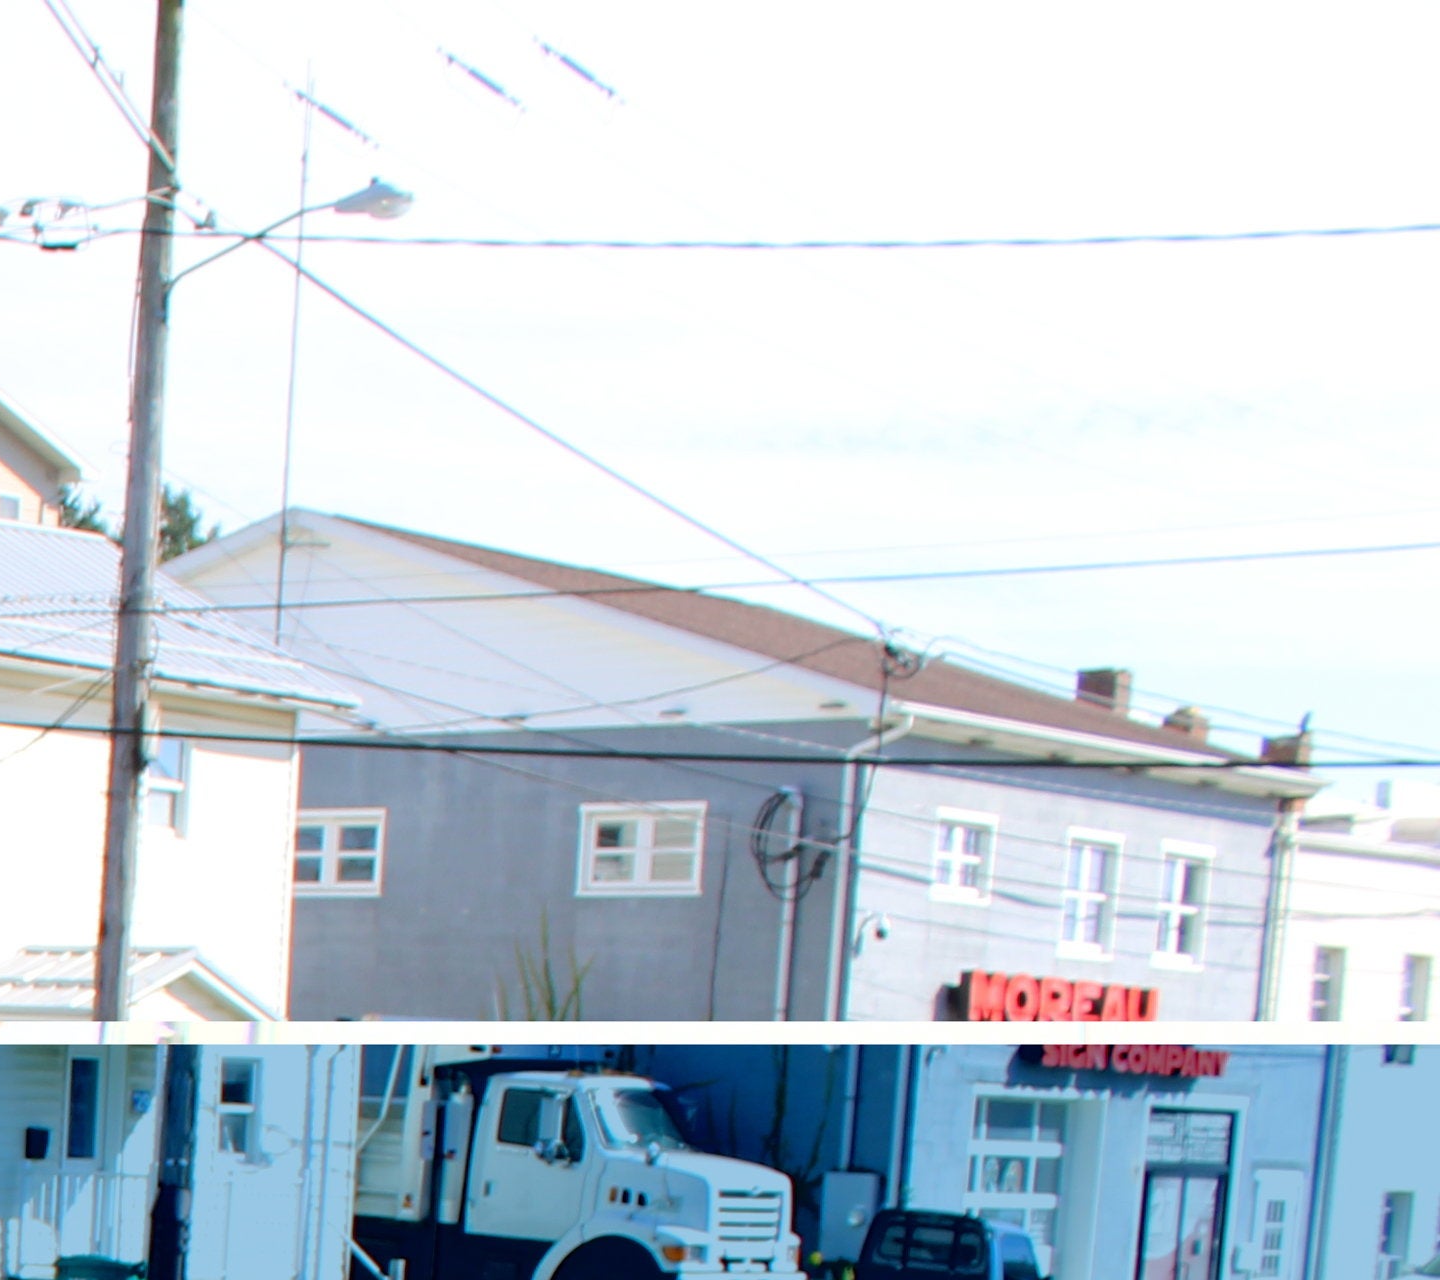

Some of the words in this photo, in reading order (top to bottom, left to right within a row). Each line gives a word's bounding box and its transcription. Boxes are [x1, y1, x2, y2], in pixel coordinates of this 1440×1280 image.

[967, 969, 1160, 1021] MOREAU
[1041, 1044, 1109, 1069] SIGN
[1110, 1044, 1231, 1078] COMPANY
